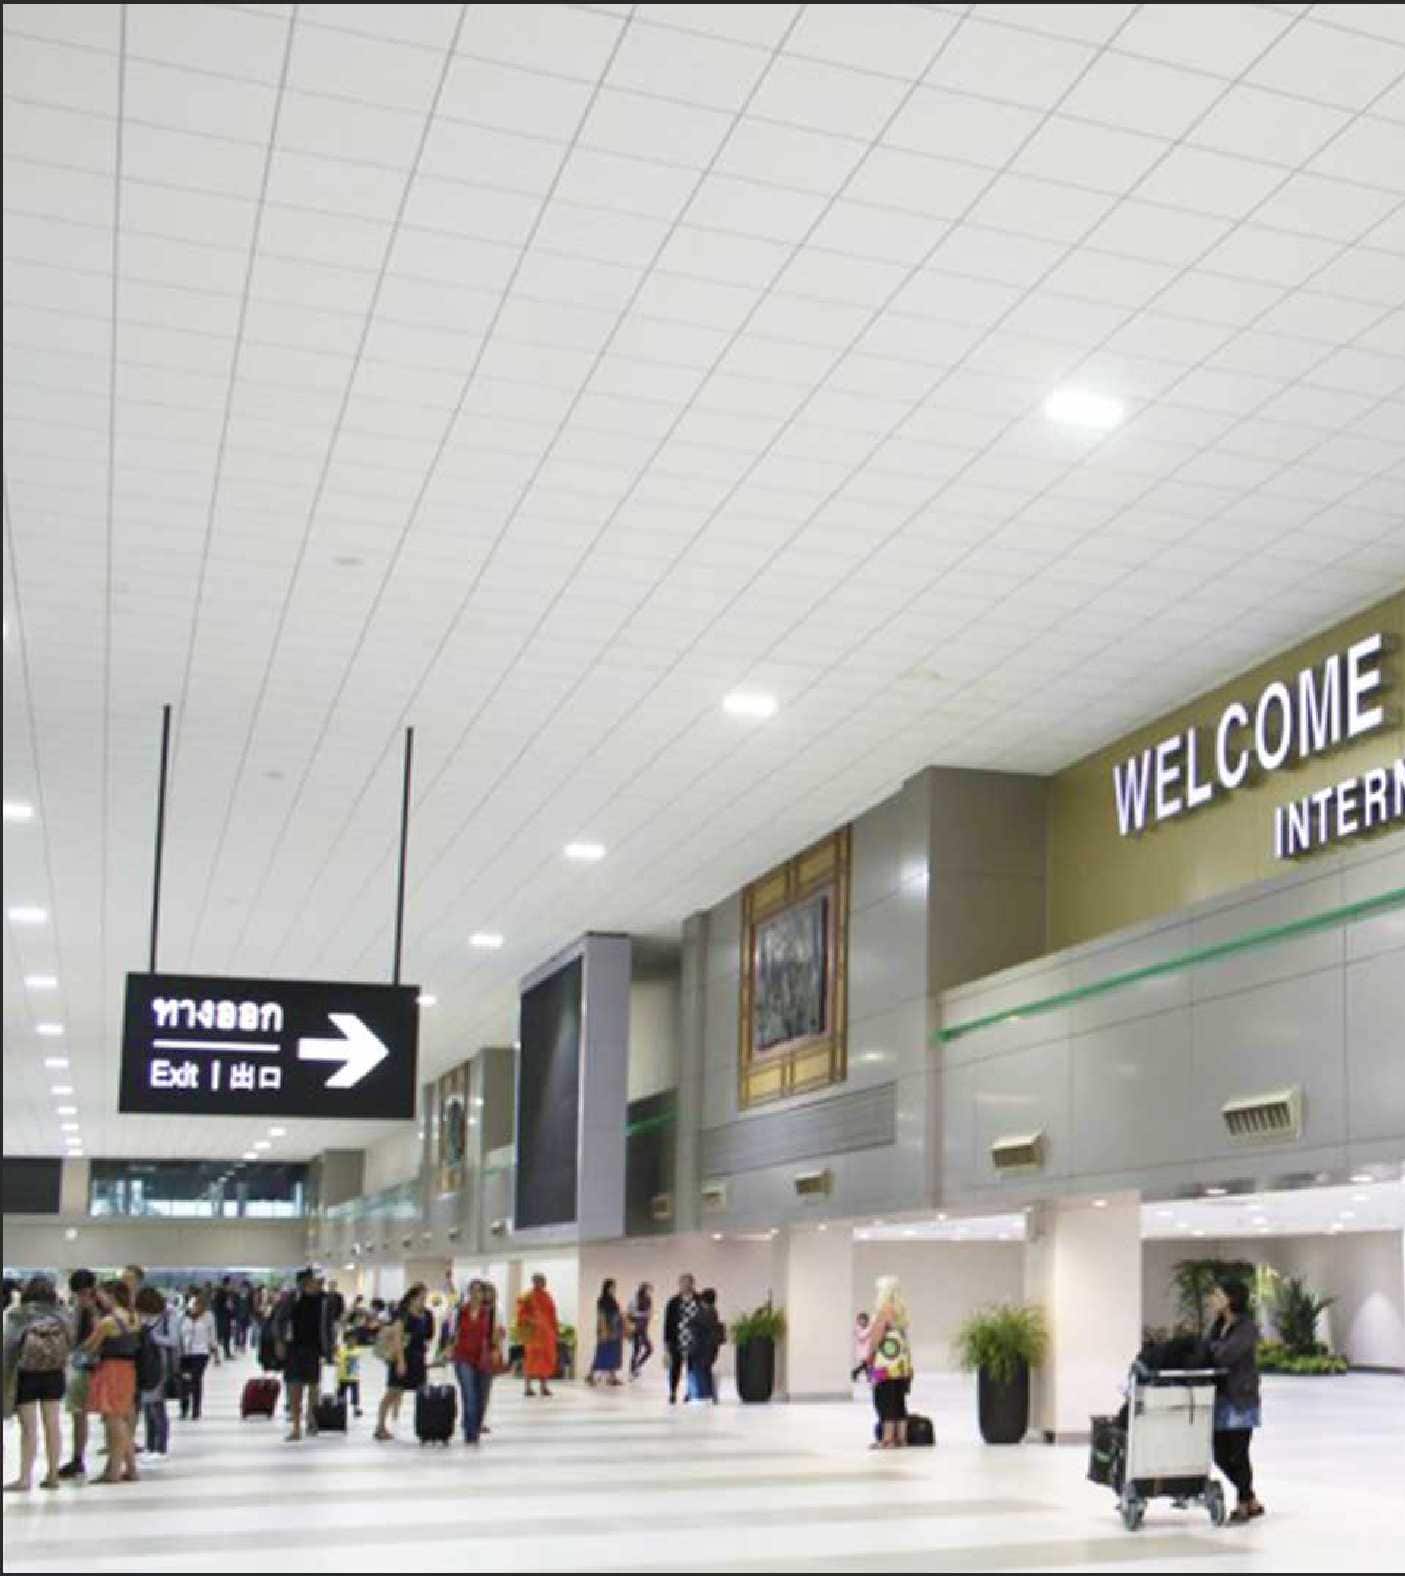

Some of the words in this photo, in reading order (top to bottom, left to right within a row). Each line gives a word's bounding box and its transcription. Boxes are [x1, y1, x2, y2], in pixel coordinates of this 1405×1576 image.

[1112, 632, 1386, 837] WELCOME
[152, 998, 284, 1033] ทางออก
[149, 1058, 200, 1090] Exit
[229, 1062, 282, 1090] 出口
